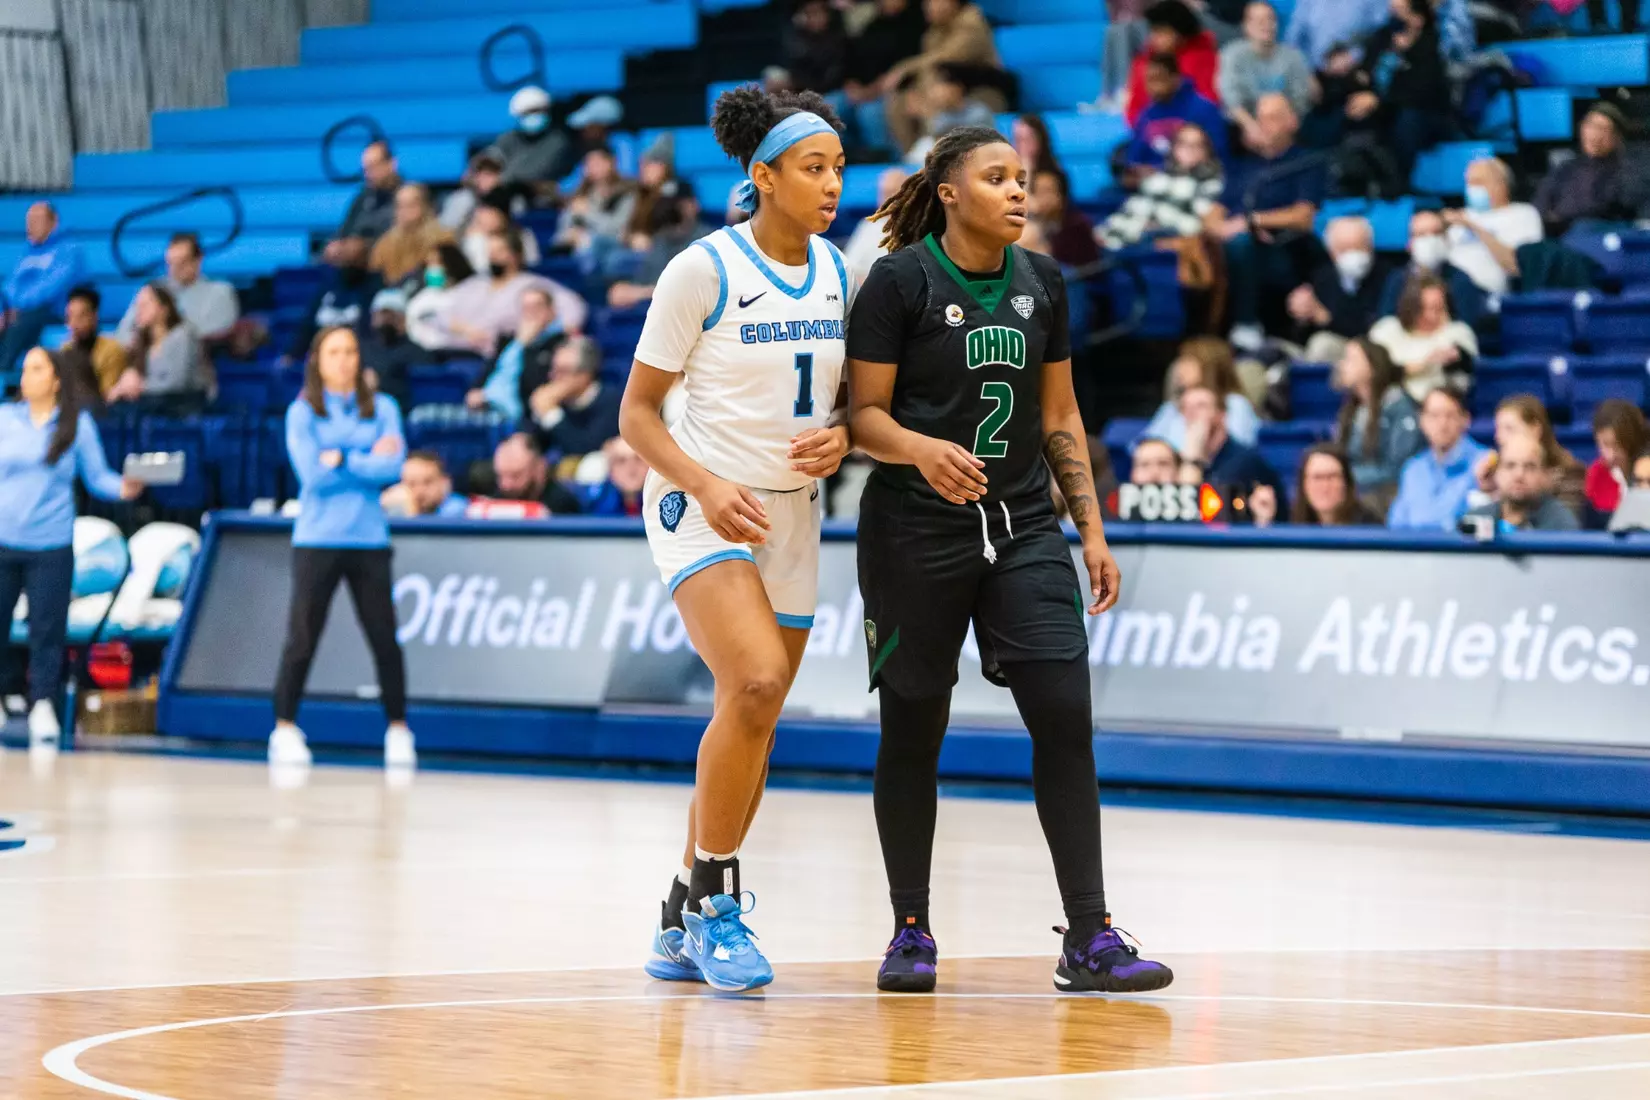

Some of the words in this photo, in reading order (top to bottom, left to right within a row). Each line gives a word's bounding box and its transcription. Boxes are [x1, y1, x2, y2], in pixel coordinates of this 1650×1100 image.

[966, 325, 1026, 370] OHIO
[793, 352, 814, 418] 1
[972, 381, 1014, 458] 2
[391, 574, 595, 647] Official
[1298, 598, 1649, 686] Athletics.
